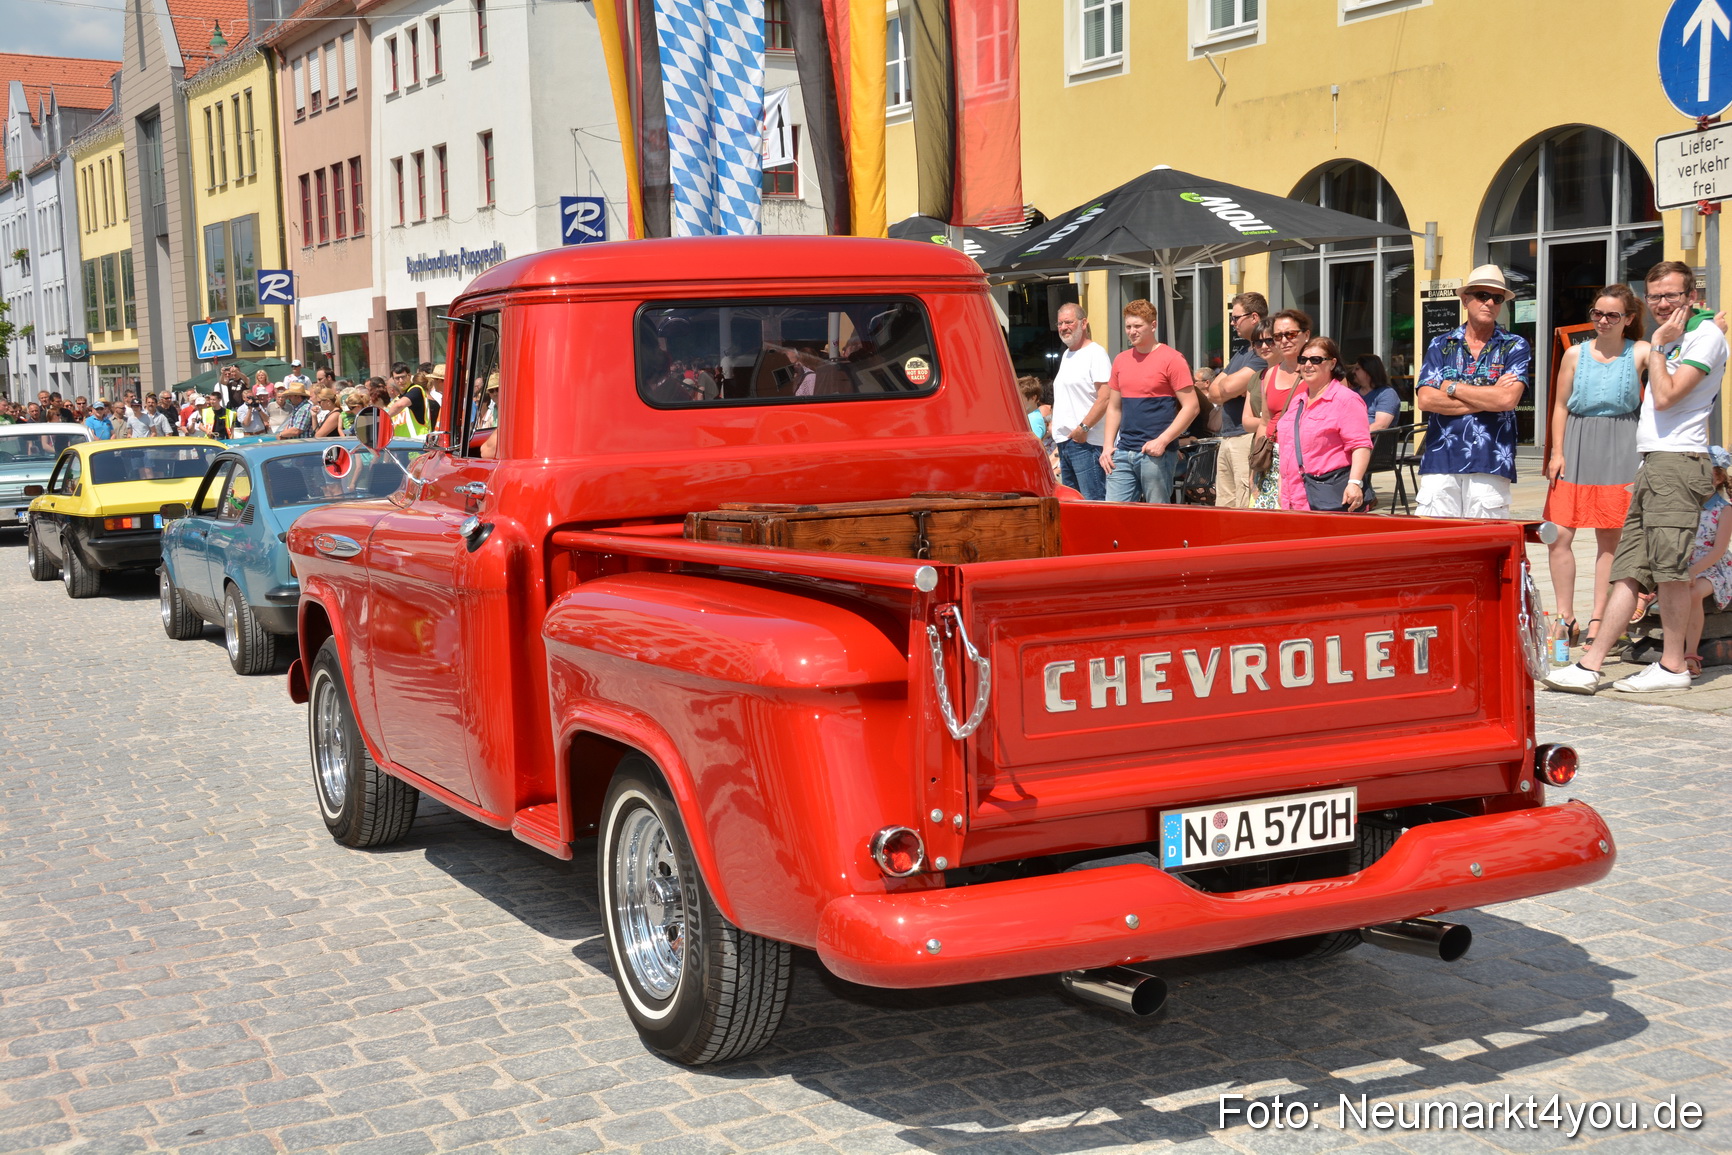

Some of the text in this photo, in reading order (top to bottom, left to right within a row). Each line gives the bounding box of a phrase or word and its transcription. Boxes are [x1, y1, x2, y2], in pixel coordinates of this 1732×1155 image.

[1680, 137, 1724, 157] Liefer-
[1677, 155, 1730, 178] verkehr
[1693, 177, 1716, 197] frei
[406, 253, 460, 275] Buchhandlung
[1427, 289, 1454, 298] BAVARIA
[1043, 625, 1438, 713] CHEVROLET
[1184, 816, 1207, 858] N
[1167, 845, 1177, 858] D
[682, 863, 701, 993] Hankoo
